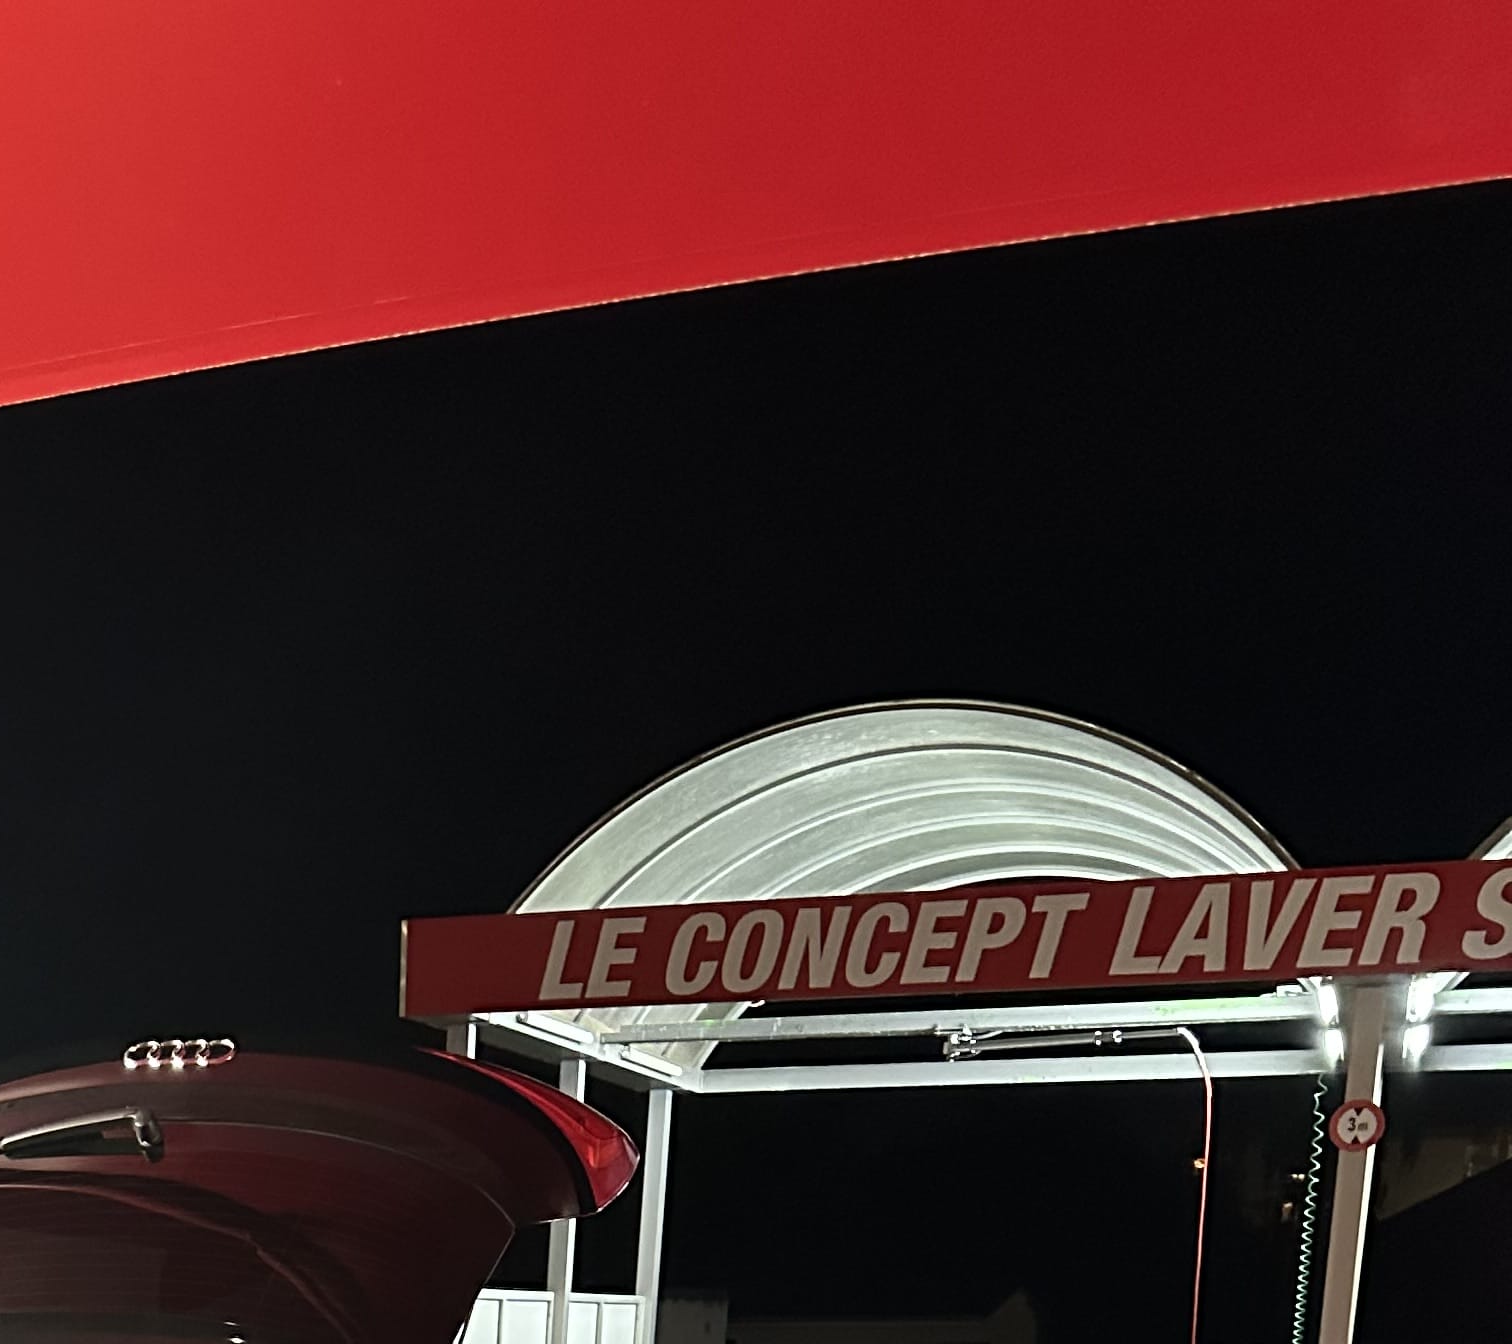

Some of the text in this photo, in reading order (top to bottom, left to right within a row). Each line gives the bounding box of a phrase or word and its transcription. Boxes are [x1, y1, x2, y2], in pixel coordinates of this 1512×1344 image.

[538, 916, 648, 1001] LE
[664, 892, 1090, 997] CONCEPT
[1108, 871, 1441, 976] LAVER
